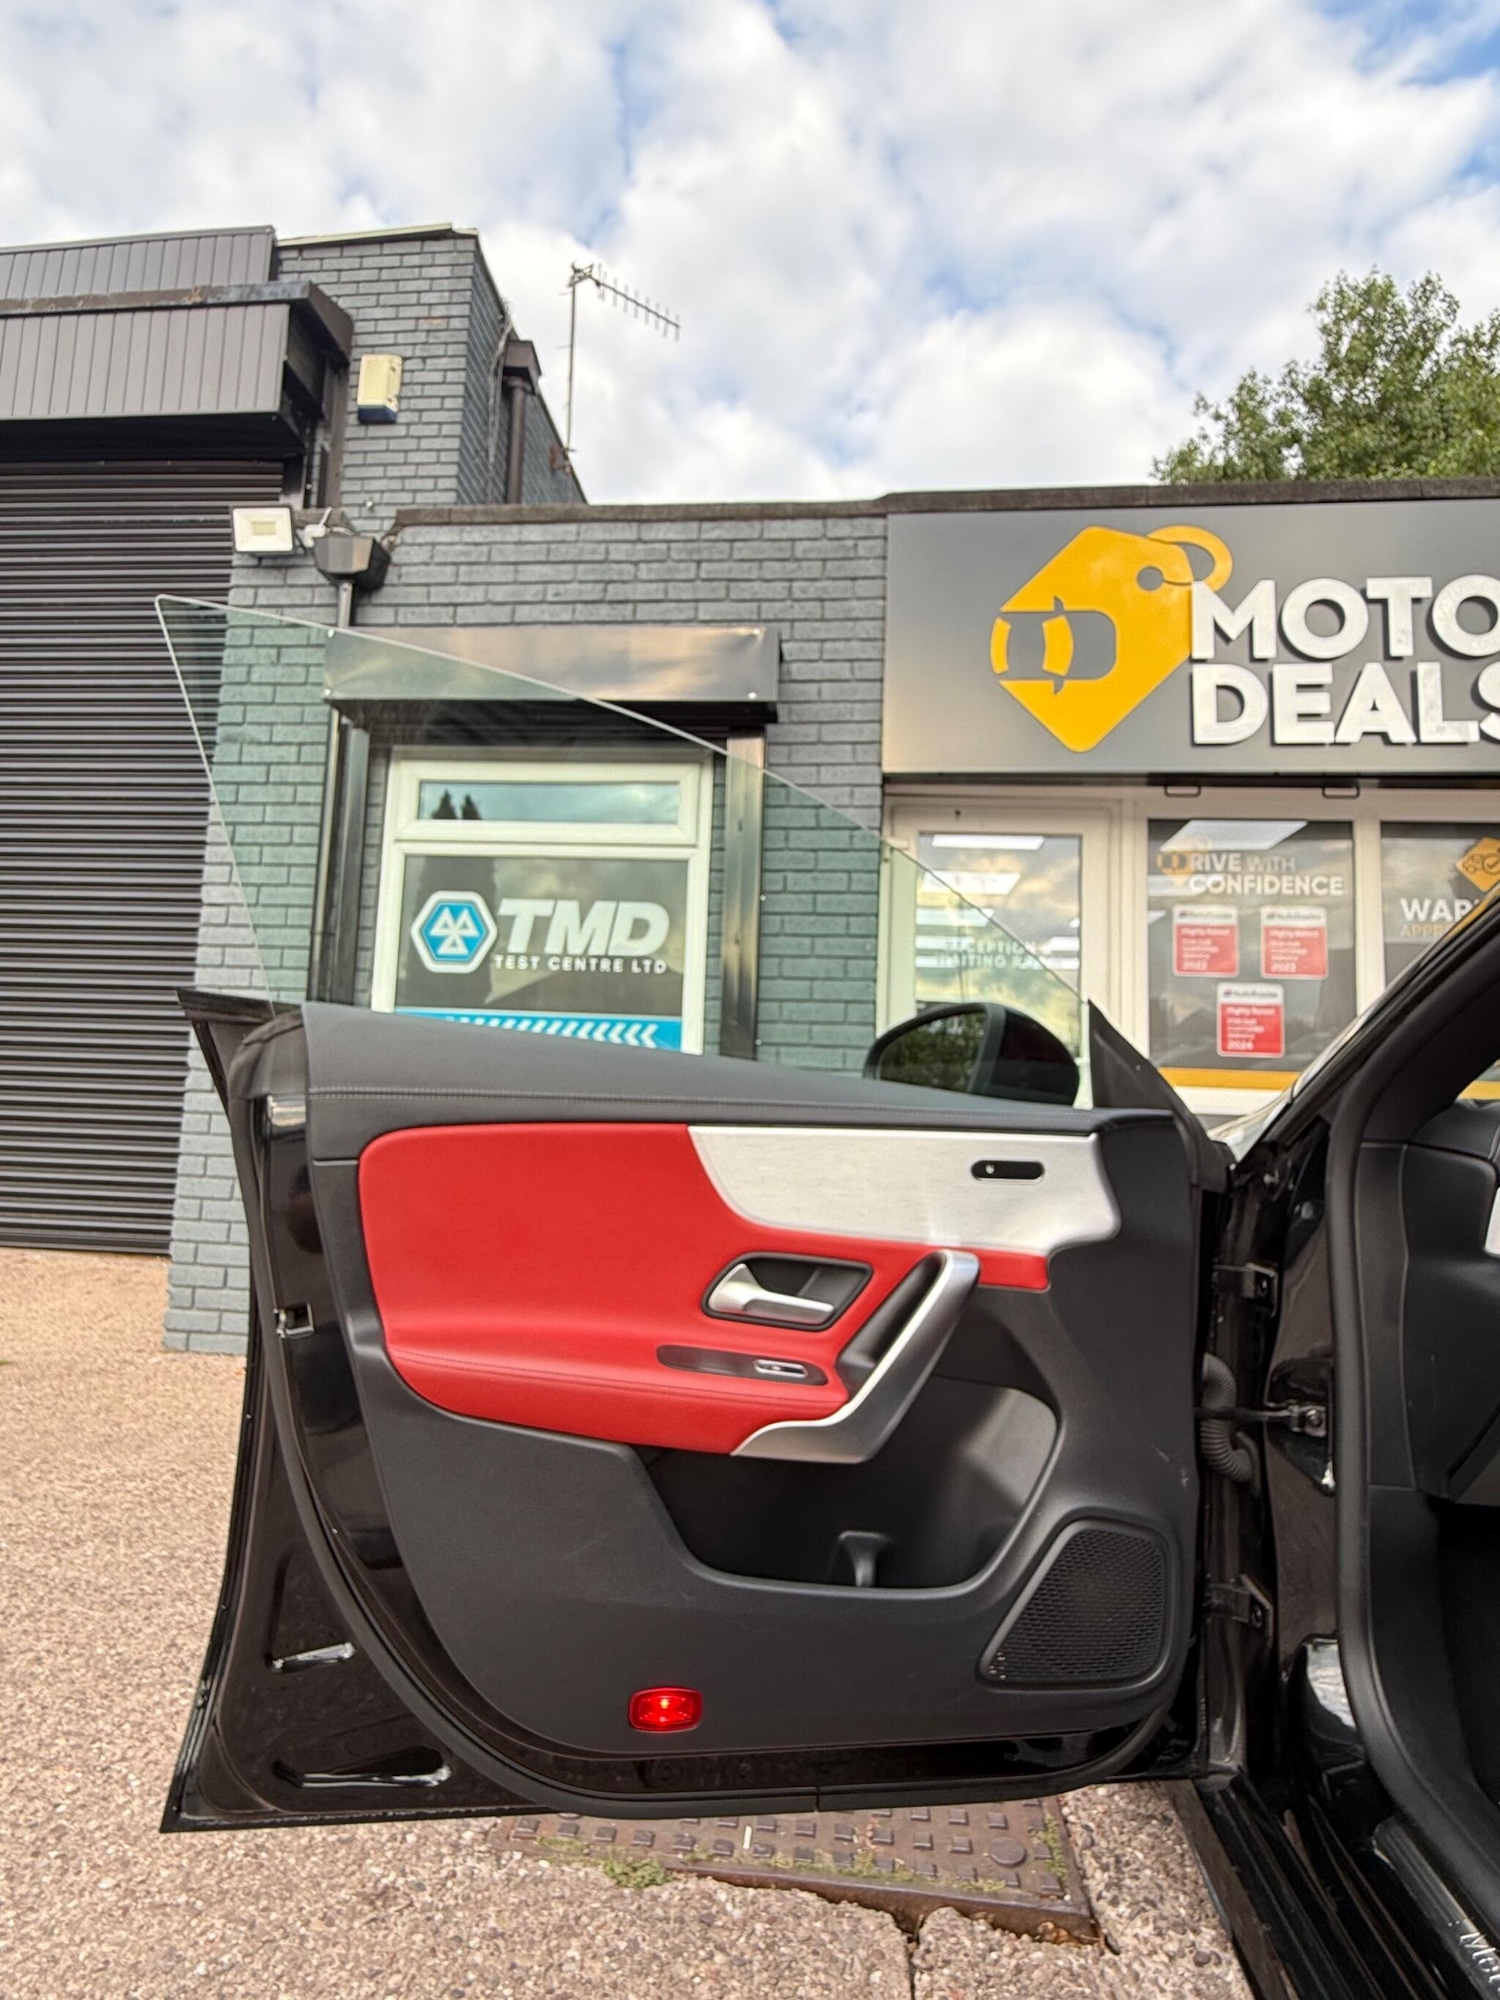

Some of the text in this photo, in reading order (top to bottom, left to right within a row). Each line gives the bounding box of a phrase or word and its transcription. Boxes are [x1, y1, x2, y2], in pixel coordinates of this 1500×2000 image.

[1246, 854, 1296, 873] WITH
[1188, 874, 1344, 896] CONFIDENCE
[498, 898, 670, 956] TMD
[493, 954, 667, 975] TEST CENTRE LTD
